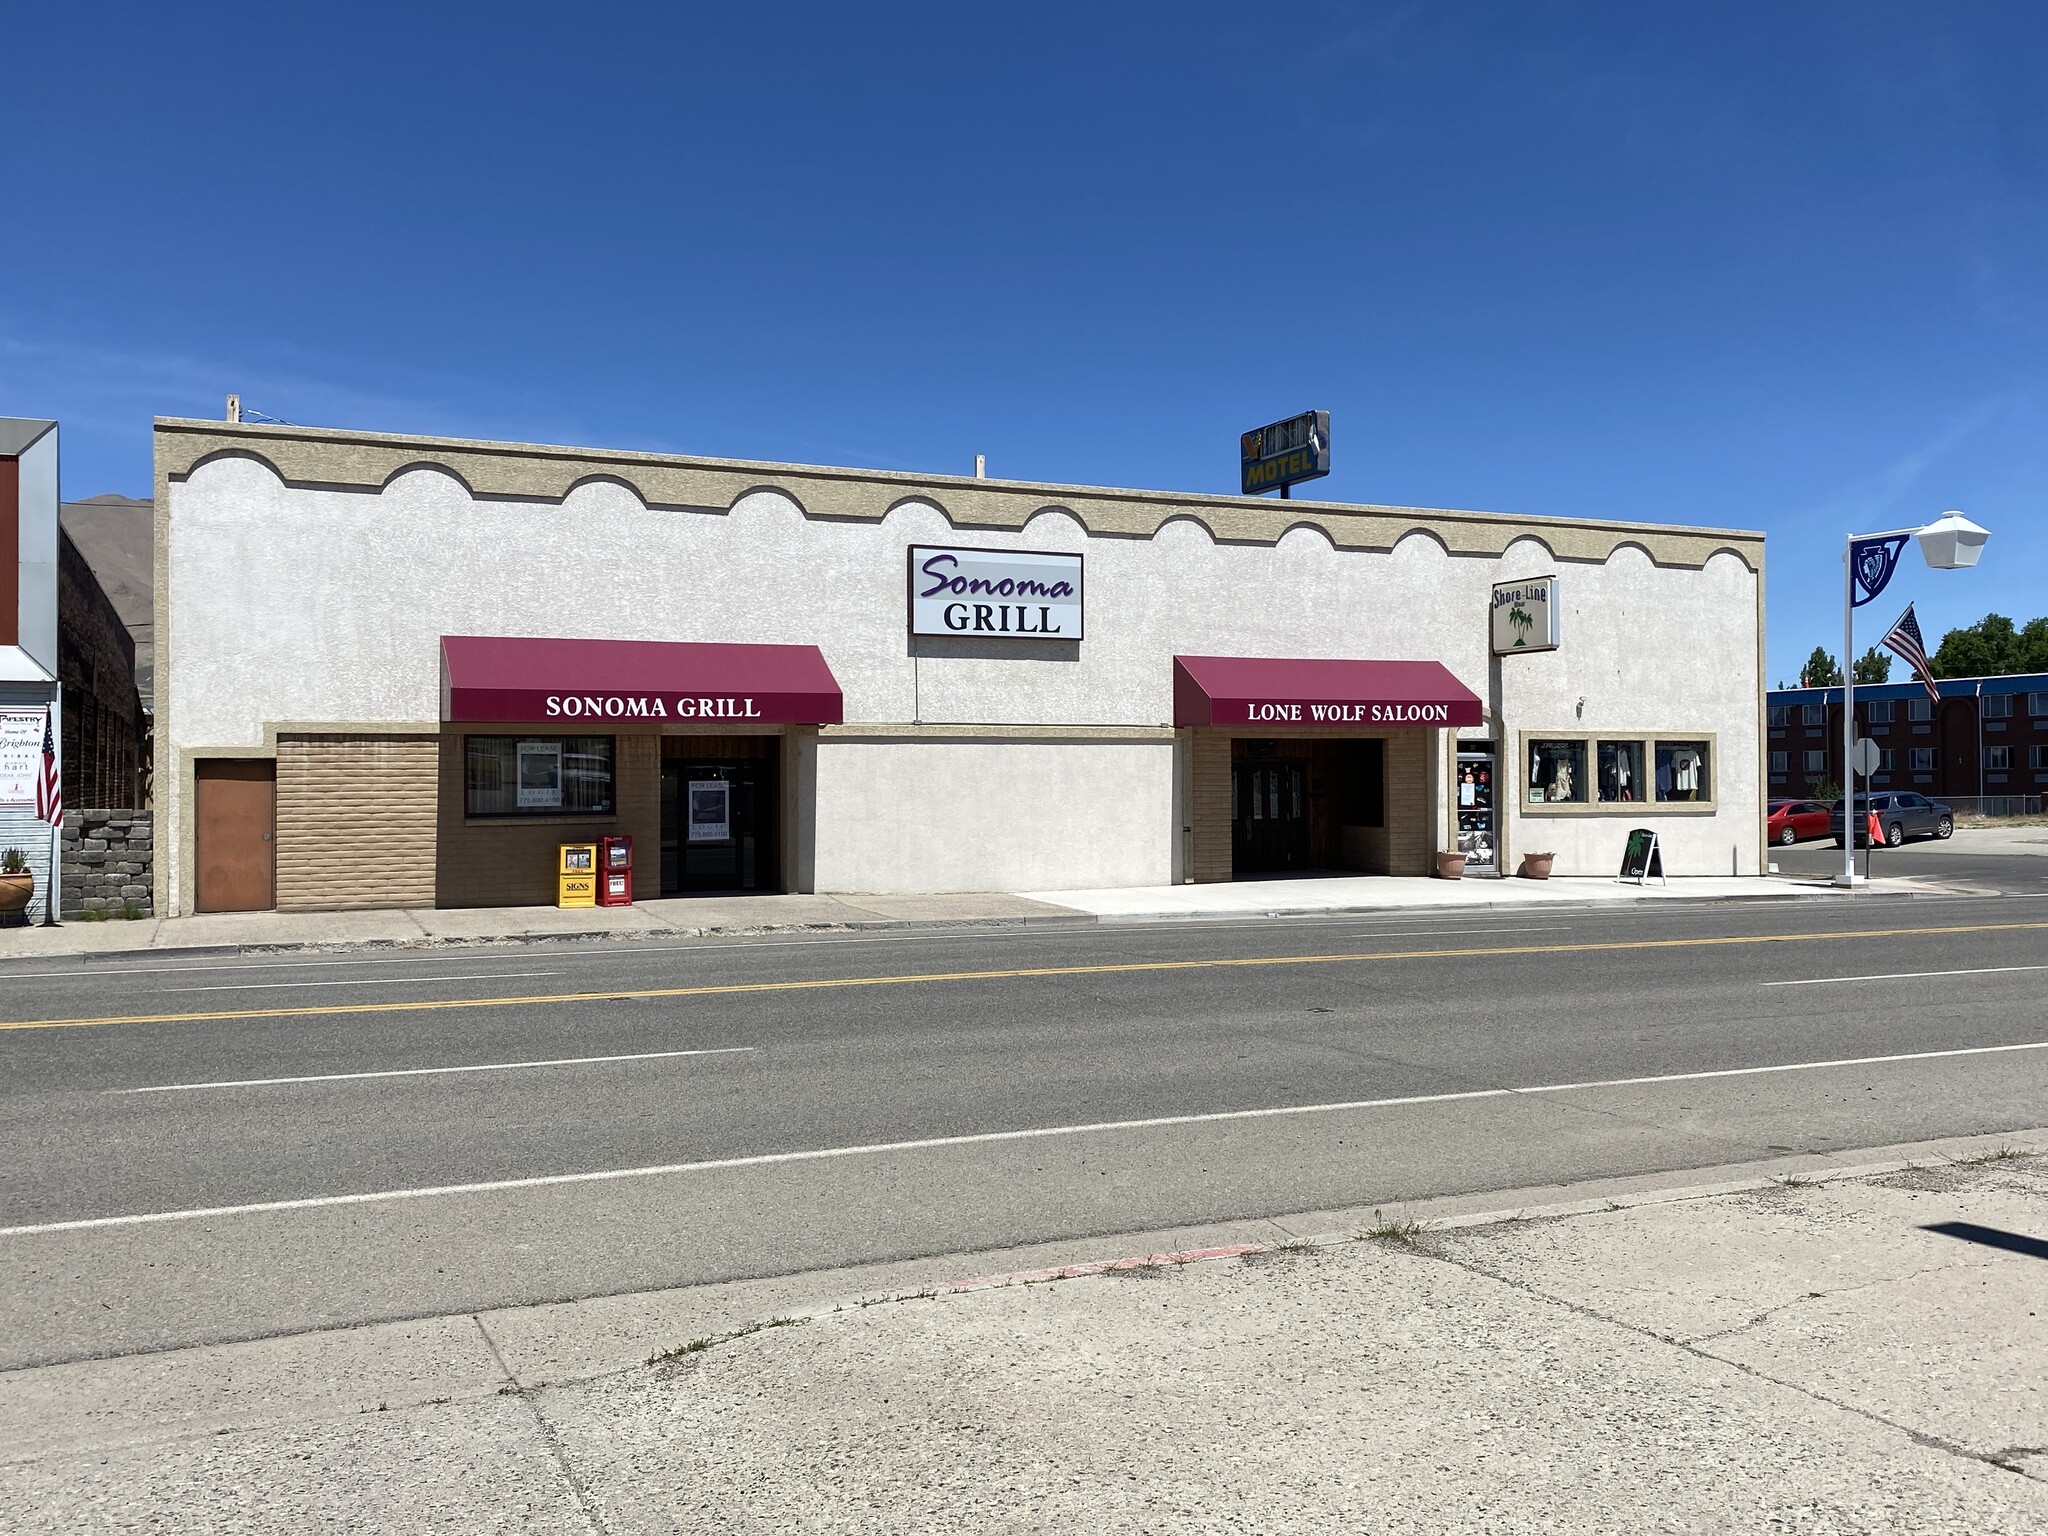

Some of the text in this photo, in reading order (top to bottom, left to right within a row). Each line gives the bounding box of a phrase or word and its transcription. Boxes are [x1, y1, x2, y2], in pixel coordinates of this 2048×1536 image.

[1247, 452, 1312, 486] MOTEL
[921, 554, 1073, 598] Sonoma
[943, 603, 1061, 633] GRILL
[546, 696, 761, 717] SONOMA GRILL
[1248, 704, 1449, 721] LONE WOLF SALOON
[566, 883, 589, 891] SIGNS
